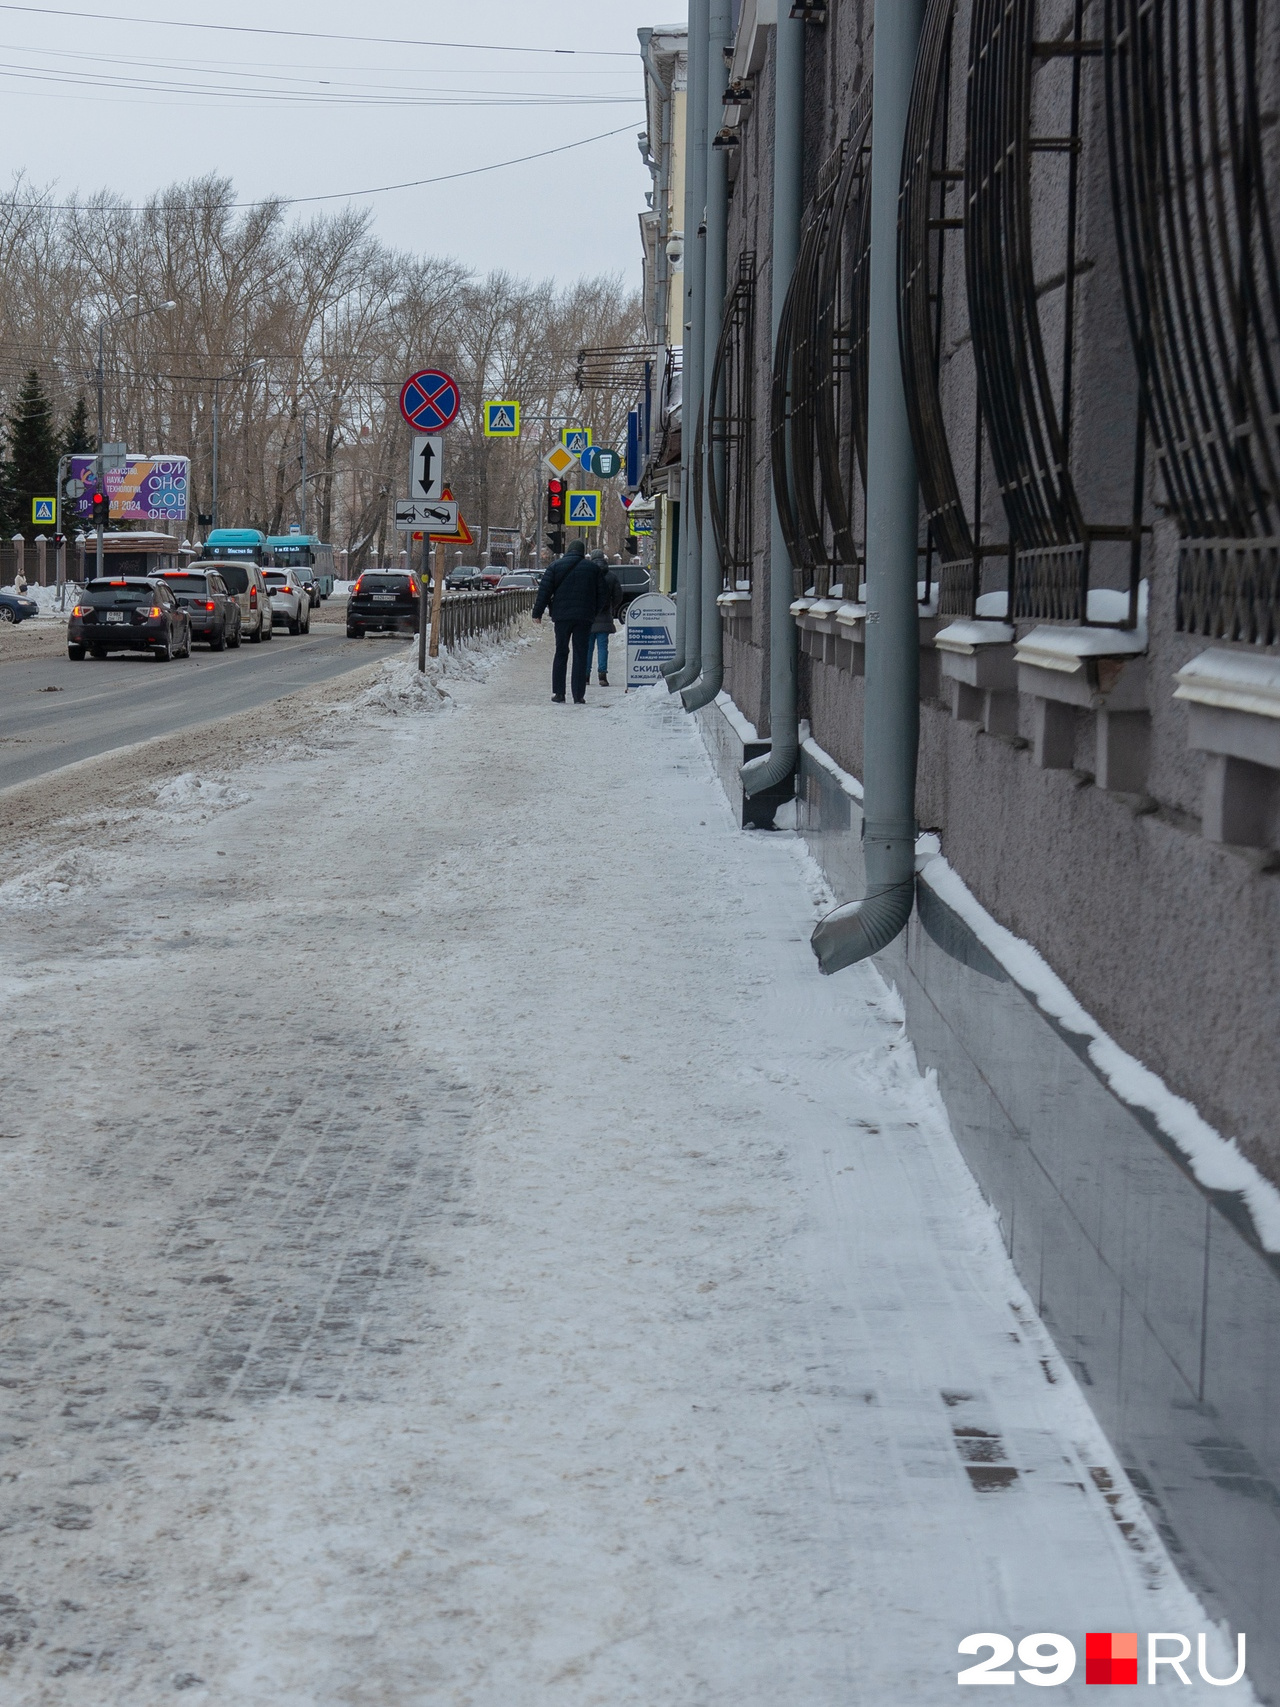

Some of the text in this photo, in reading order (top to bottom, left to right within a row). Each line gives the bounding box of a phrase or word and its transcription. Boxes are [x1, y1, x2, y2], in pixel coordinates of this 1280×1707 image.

[149, 462, 186, 474] ЛОМ
[148, 476, 187, 490] ОНО
[121, 501, 141, 510] 2024
[148, 492, 186, 507] СОВ
[147, 508, 186, 520] ФЕСТ
[633, 665, 661, 673] СКИД
